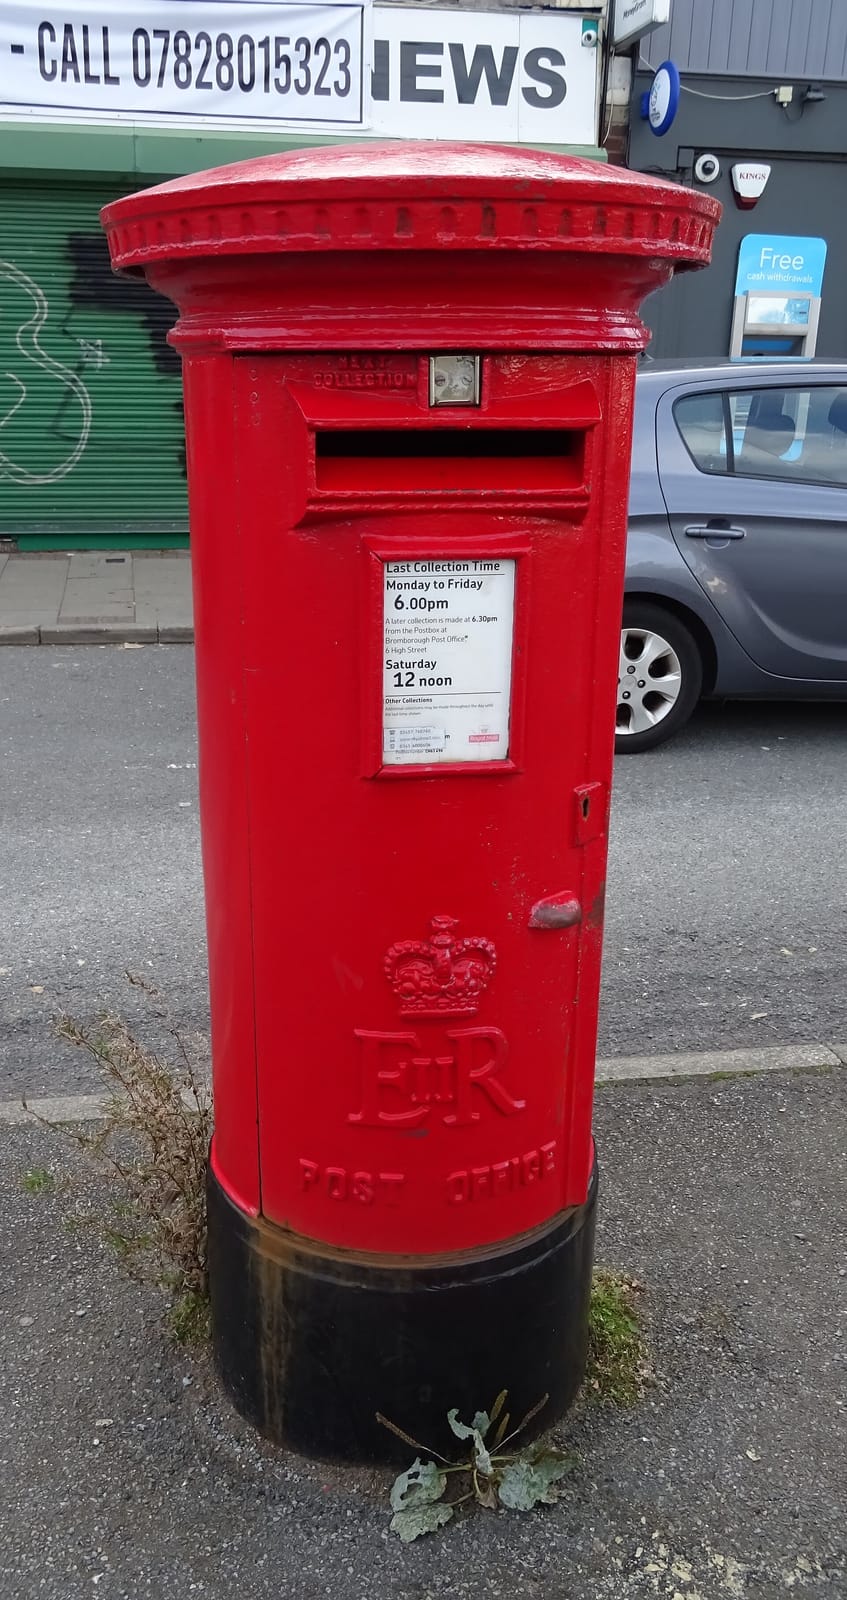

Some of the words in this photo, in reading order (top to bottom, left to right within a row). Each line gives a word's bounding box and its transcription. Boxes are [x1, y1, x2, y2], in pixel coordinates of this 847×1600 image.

[37, 21, 120, 86] CALL
[132, 28, 351, 97] 07828015323
[739, 172, 766, 180] KINGS
[759, 247, 804, 270] Free
[747, 272, 765, 281] cash
[767, 272, 813, 284] withdrawals
[313, 373, 417, 390] COLLECTION
[386, 562, 411, 574] Last
[413, 561, 469, 573] Collection
[472, 560, 500, 571] Time
[386, 580, 430, 591] Monday
[433, 580, 445, 589] to
[448, 578, 483, 590] Friday
[394, 594, 449, 612] 6.00pm
[391, 617, 406, 625] later
[407, 616, 437, 625] collection
[439, 616, 444, 624] is
[445, 615, 463, 624] made
[471, 615, 498, 623] 6.30pm
[385, 627, 401, 635] from
[385, 637, 430, 645] Bromborough
[432, 635, 445, 643] Post
[391, 646, 406, 655] High
[386, 659, 437, 671] Saturday
[393, 671, 415, 688] 12
[419, 676, 452, 687] noon
[402, 695, 433, 703] Collections
[299, 1158, 405, 1208] POST
[447, 1140, 557, 1203] OFFICE
